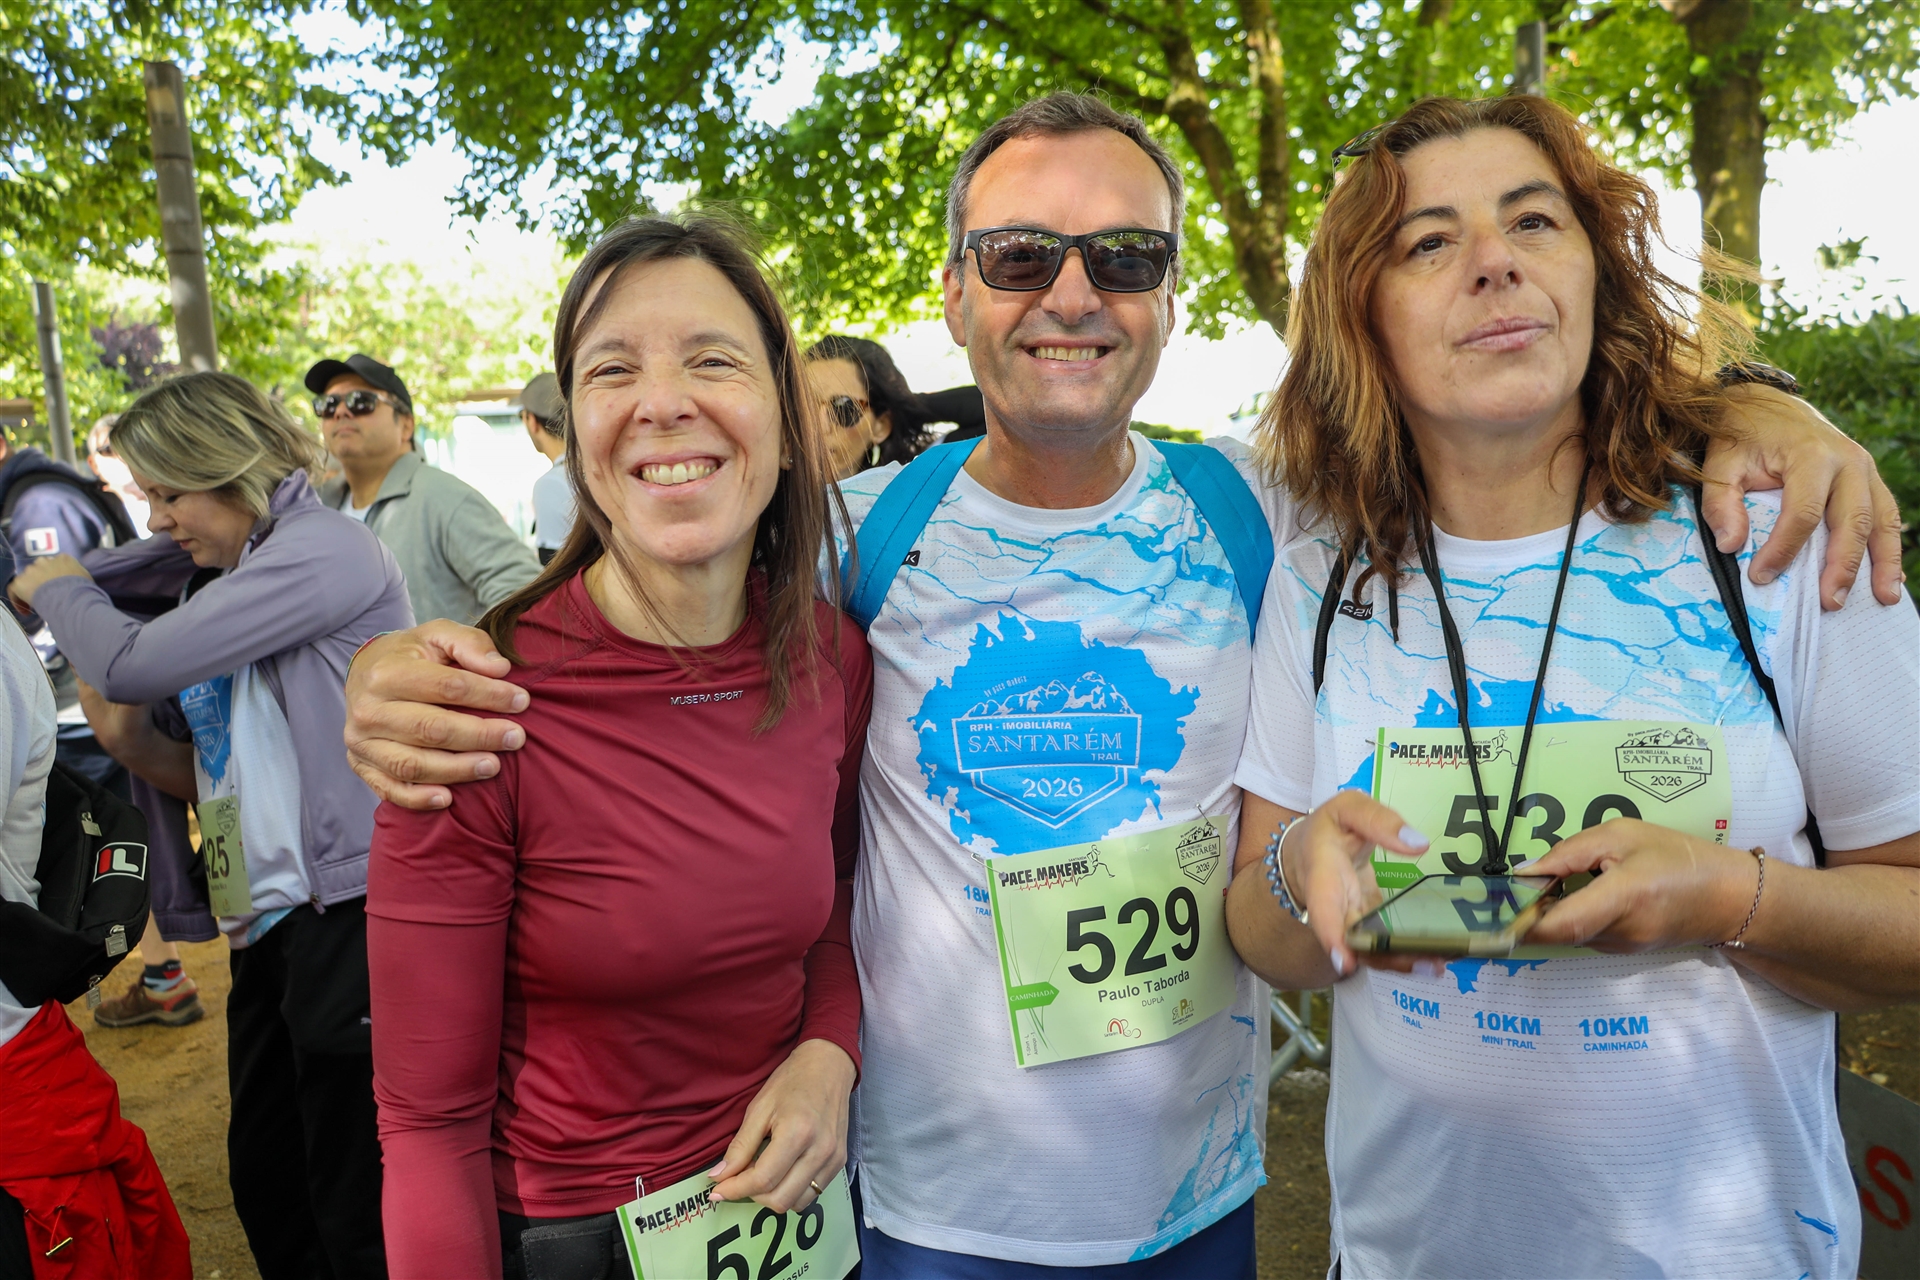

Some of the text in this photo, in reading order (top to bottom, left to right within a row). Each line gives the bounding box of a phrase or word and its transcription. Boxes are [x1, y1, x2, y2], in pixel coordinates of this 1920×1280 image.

[670, 690, 744, 706] MUSERA SPORT
[969, 724, 993, 732] RPH
[1002, 720, 1072, 731] IMOBILIÁRIA
[968, 728, 1122, 753] SANTARÉM
[1091, 753, 1123, 762] TRAIL
[1623, 754, 1704, 765] SANTARÉM
[1022, 777, 1083, 799] 2026
[1651, 775, 1682, 786] 2026
[1000, 860, 1090, 888] PACE.MAKERS
[1375, 871, 1420, 879] AMINHADA
[1066, 886, 1200, 984] 529
[1098, 969, 1190, 1003] Paulo Taborda
[1010, 989, 1055, 1002] CAMINHADA
[1141, 996, 1165, 1007] DUPLA
[1391, 989, 1440, 1020] 18KM
[1402, 1014, 1424, 1030] TRAIL
[1474, 1010, 1542, 1036] 10KM
[1578, 1015, 1650, 1038] 10KM
[1481, 1034, 1537, 1050] MINI TRAIL
[1583, 1040, 1649, 1052] CAMINHADA
[707, 1197, 825, 1280] 528
